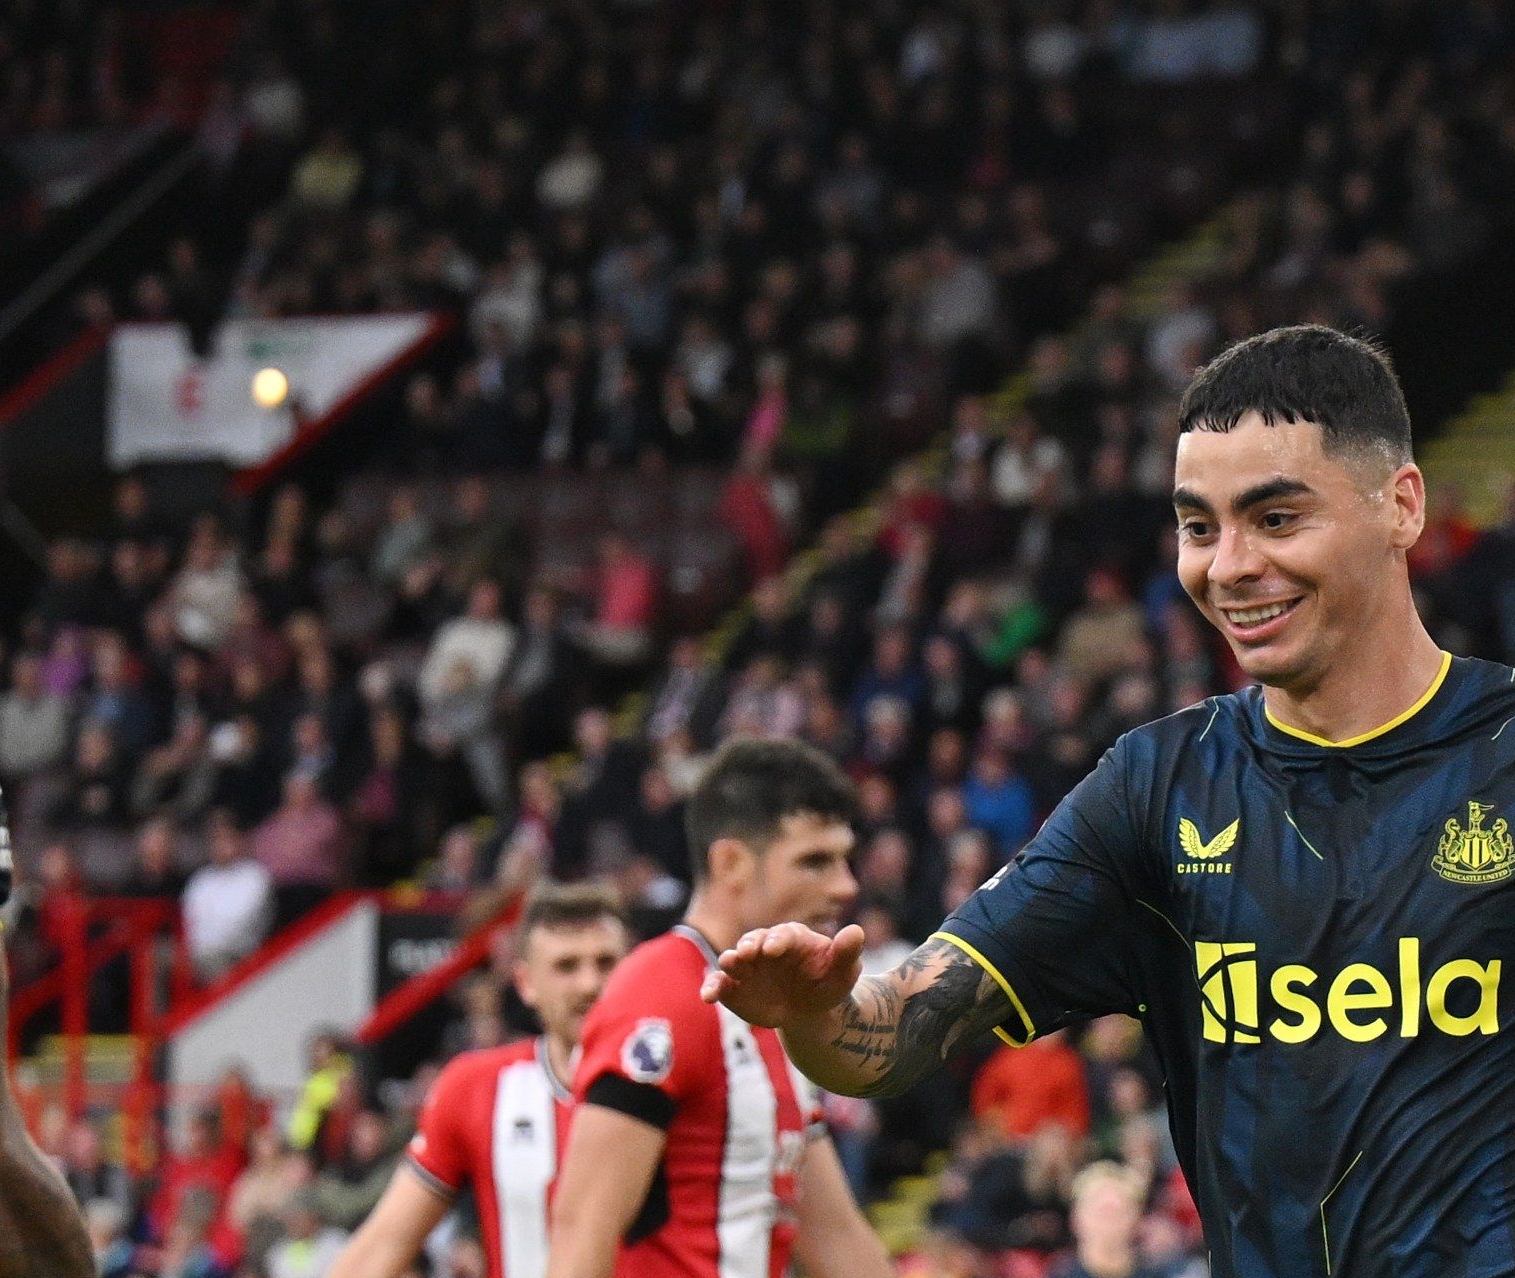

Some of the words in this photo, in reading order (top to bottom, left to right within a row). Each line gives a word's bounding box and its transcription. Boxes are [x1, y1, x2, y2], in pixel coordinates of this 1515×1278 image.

[1177, 862, 1232, 874] CASTORE
[1442, 870, 1483, 881] NEWCASTLE
[1483, 869, 1508, 881] UNITED
[1270, 937, 1502, 1044] sela
